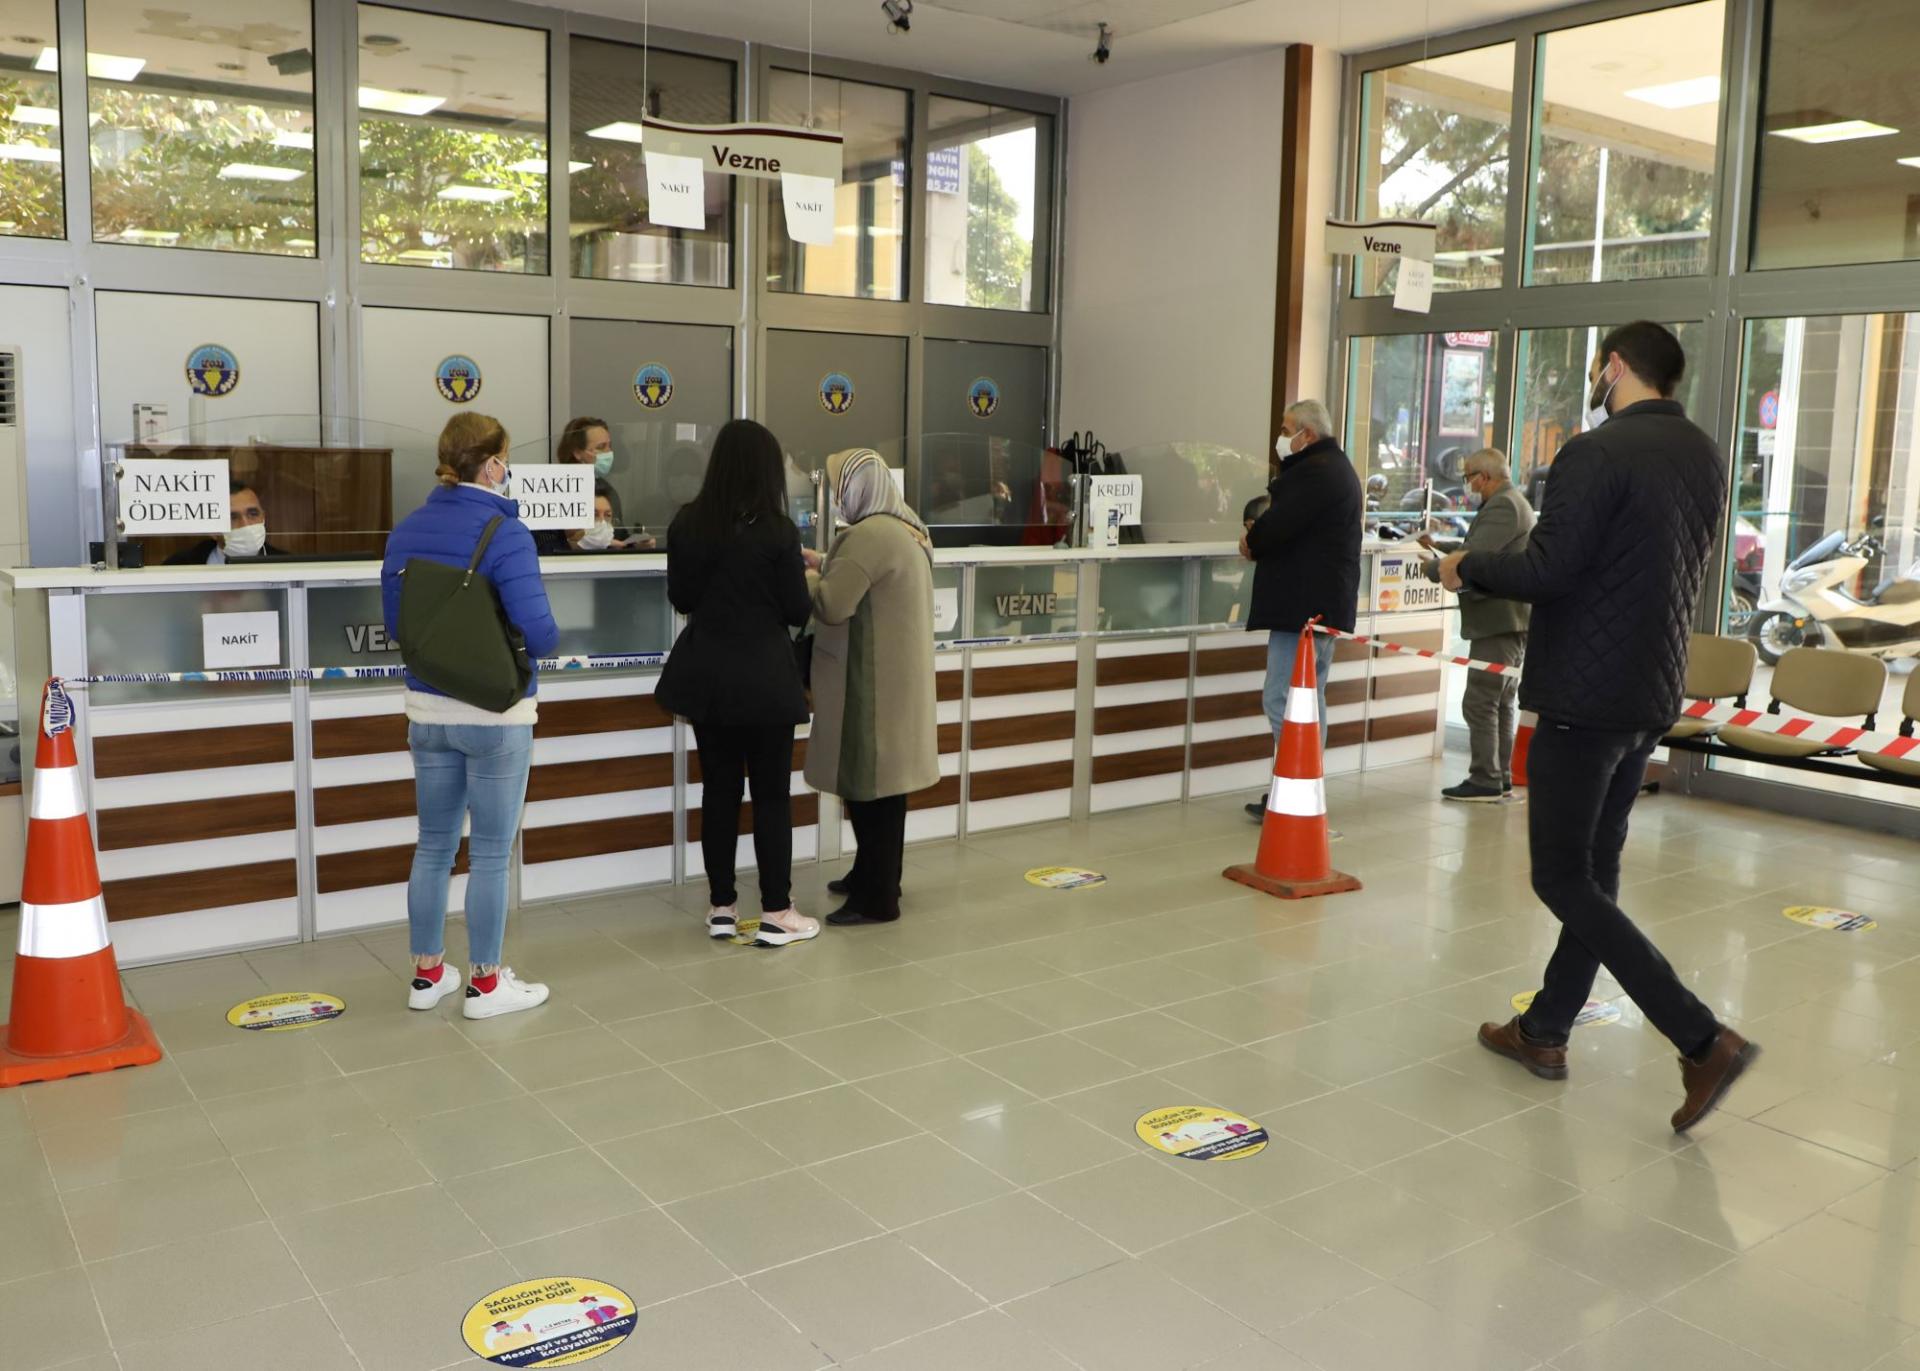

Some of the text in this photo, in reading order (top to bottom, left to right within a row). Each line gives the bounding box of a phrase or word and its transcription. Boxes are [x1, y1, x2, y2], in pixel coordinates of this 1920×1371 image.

[712, 145, 781, 173] Vezne
[660, 182, 691, 194] NAKİT
[794, 201, 823, 213] NAKİT
[1363, 235, 1402, 254] Vezne
[135, 470, 216, 492] NAKİT
[522, 474, 584, 493] NAKİT
[1097, 480, 1134, 497] KREDİ
[129, 499, 221, 521] ÖDEME
[518, 500, 588, 519] ÖDEME
[1384, 566, 1399, 576] VISA
[996, 593, 1057, 617] VEZNE
[1404, 584, 1441, 605] ÖDEME
[222, 632, 259, 645] NAKİT
[485, 1280, 570, 1309] SAĞLIĞIN İÇİN
[489, 1287, 577, 1316] BURADA DUR!
[500, 1318, 631, 1362] Mesafeyi ve sağlığımızı
[539, 1335, 604, 1358] koruyalım.
